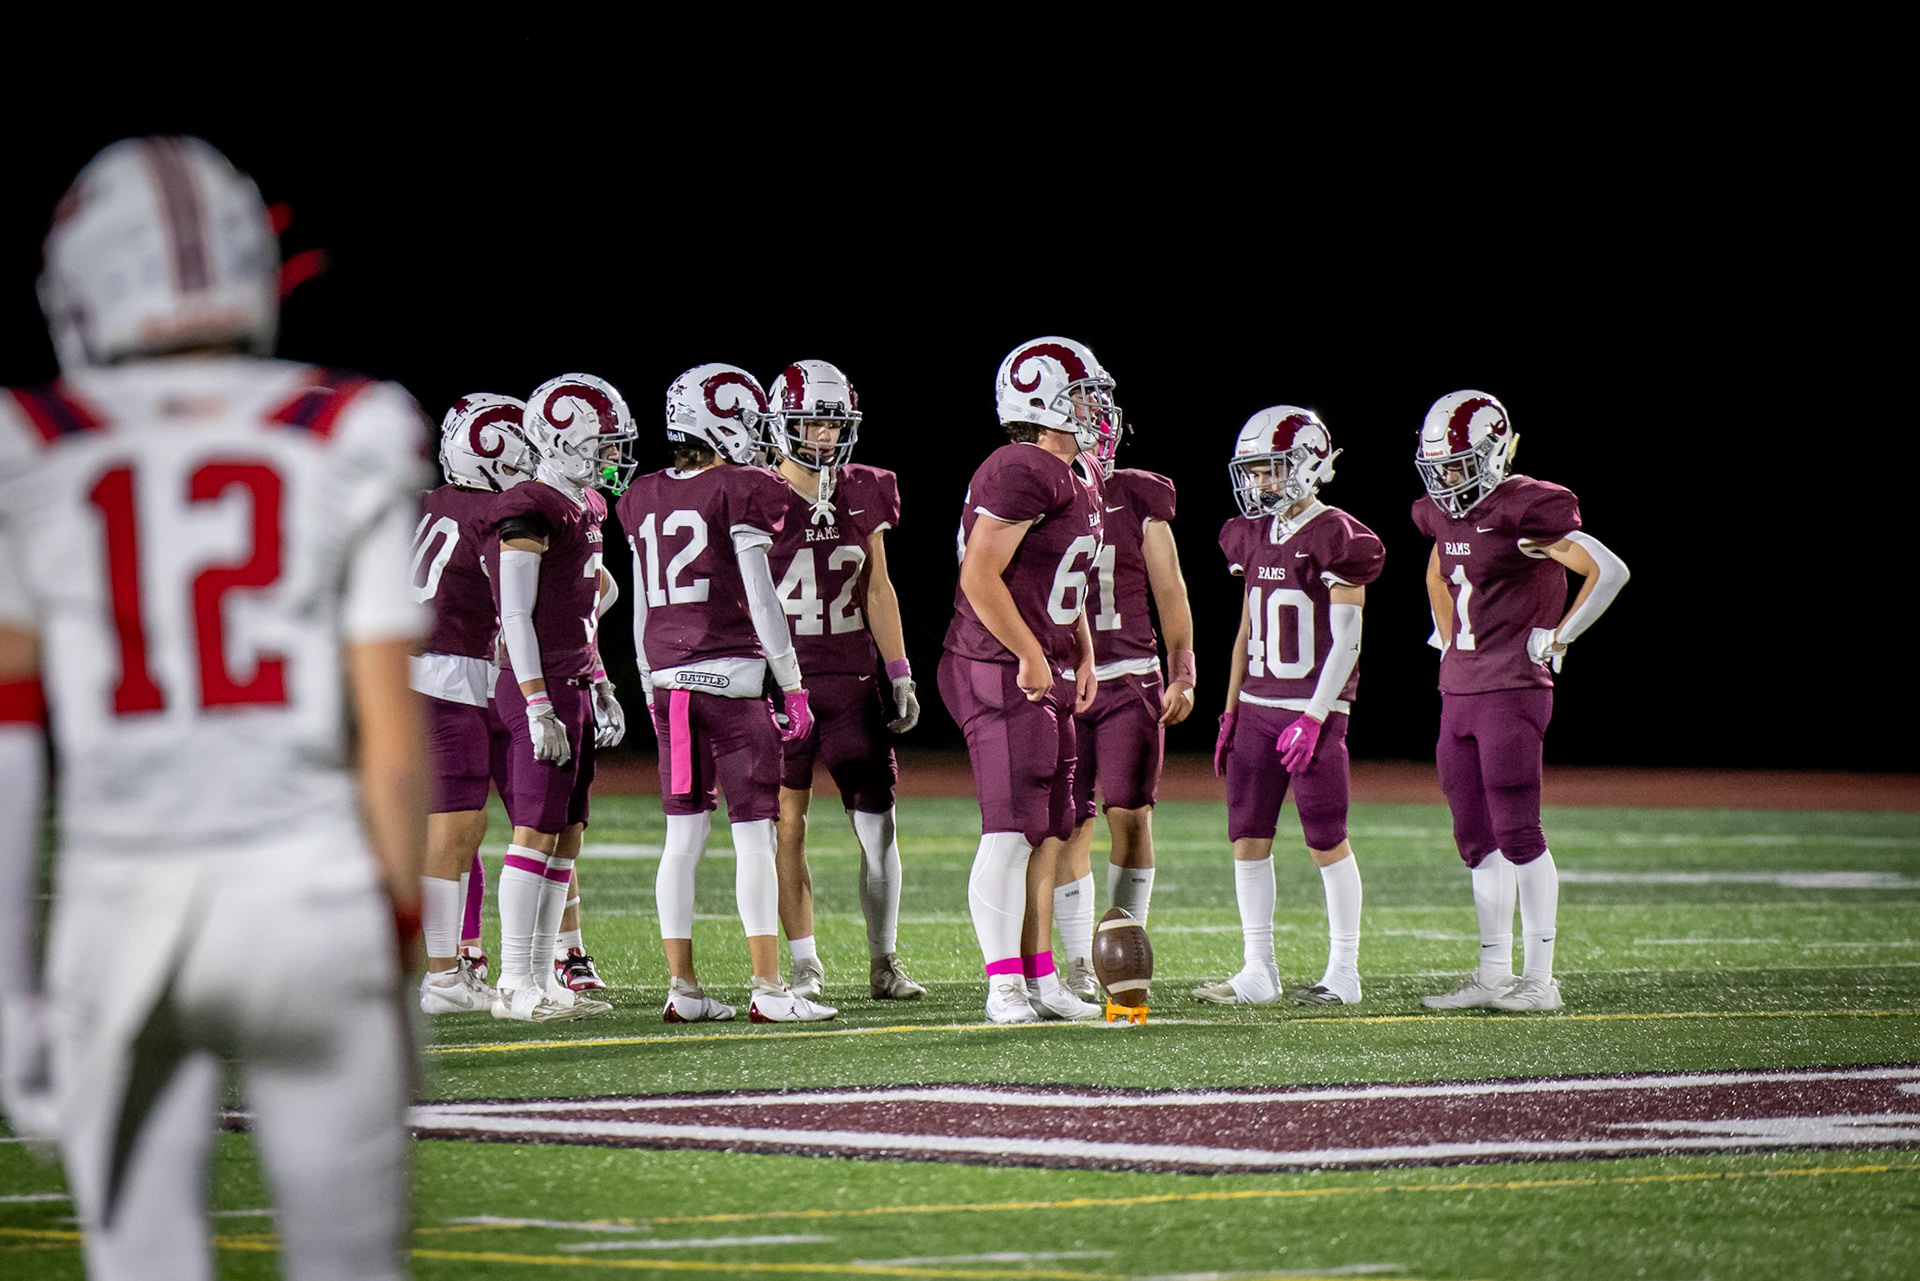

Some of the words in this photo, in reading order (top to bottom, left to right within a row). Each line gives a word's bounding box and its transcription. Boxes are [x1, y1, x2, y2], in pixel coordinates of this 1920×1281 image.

[639, 510, 710, 608] 12
[805, 527, 840, 542] RAMS
[1257, 566, 1286, 580] RAMS
[1445, 542, 1471, 555] RAMS
[88, 462, 289, 715] 12
[775, 545, 866, 635] 42
[1450, 564, 1476, 650] 1
[1247, 586, 1315, 679] 40
[680, 673, 725, 686] BATTLE
